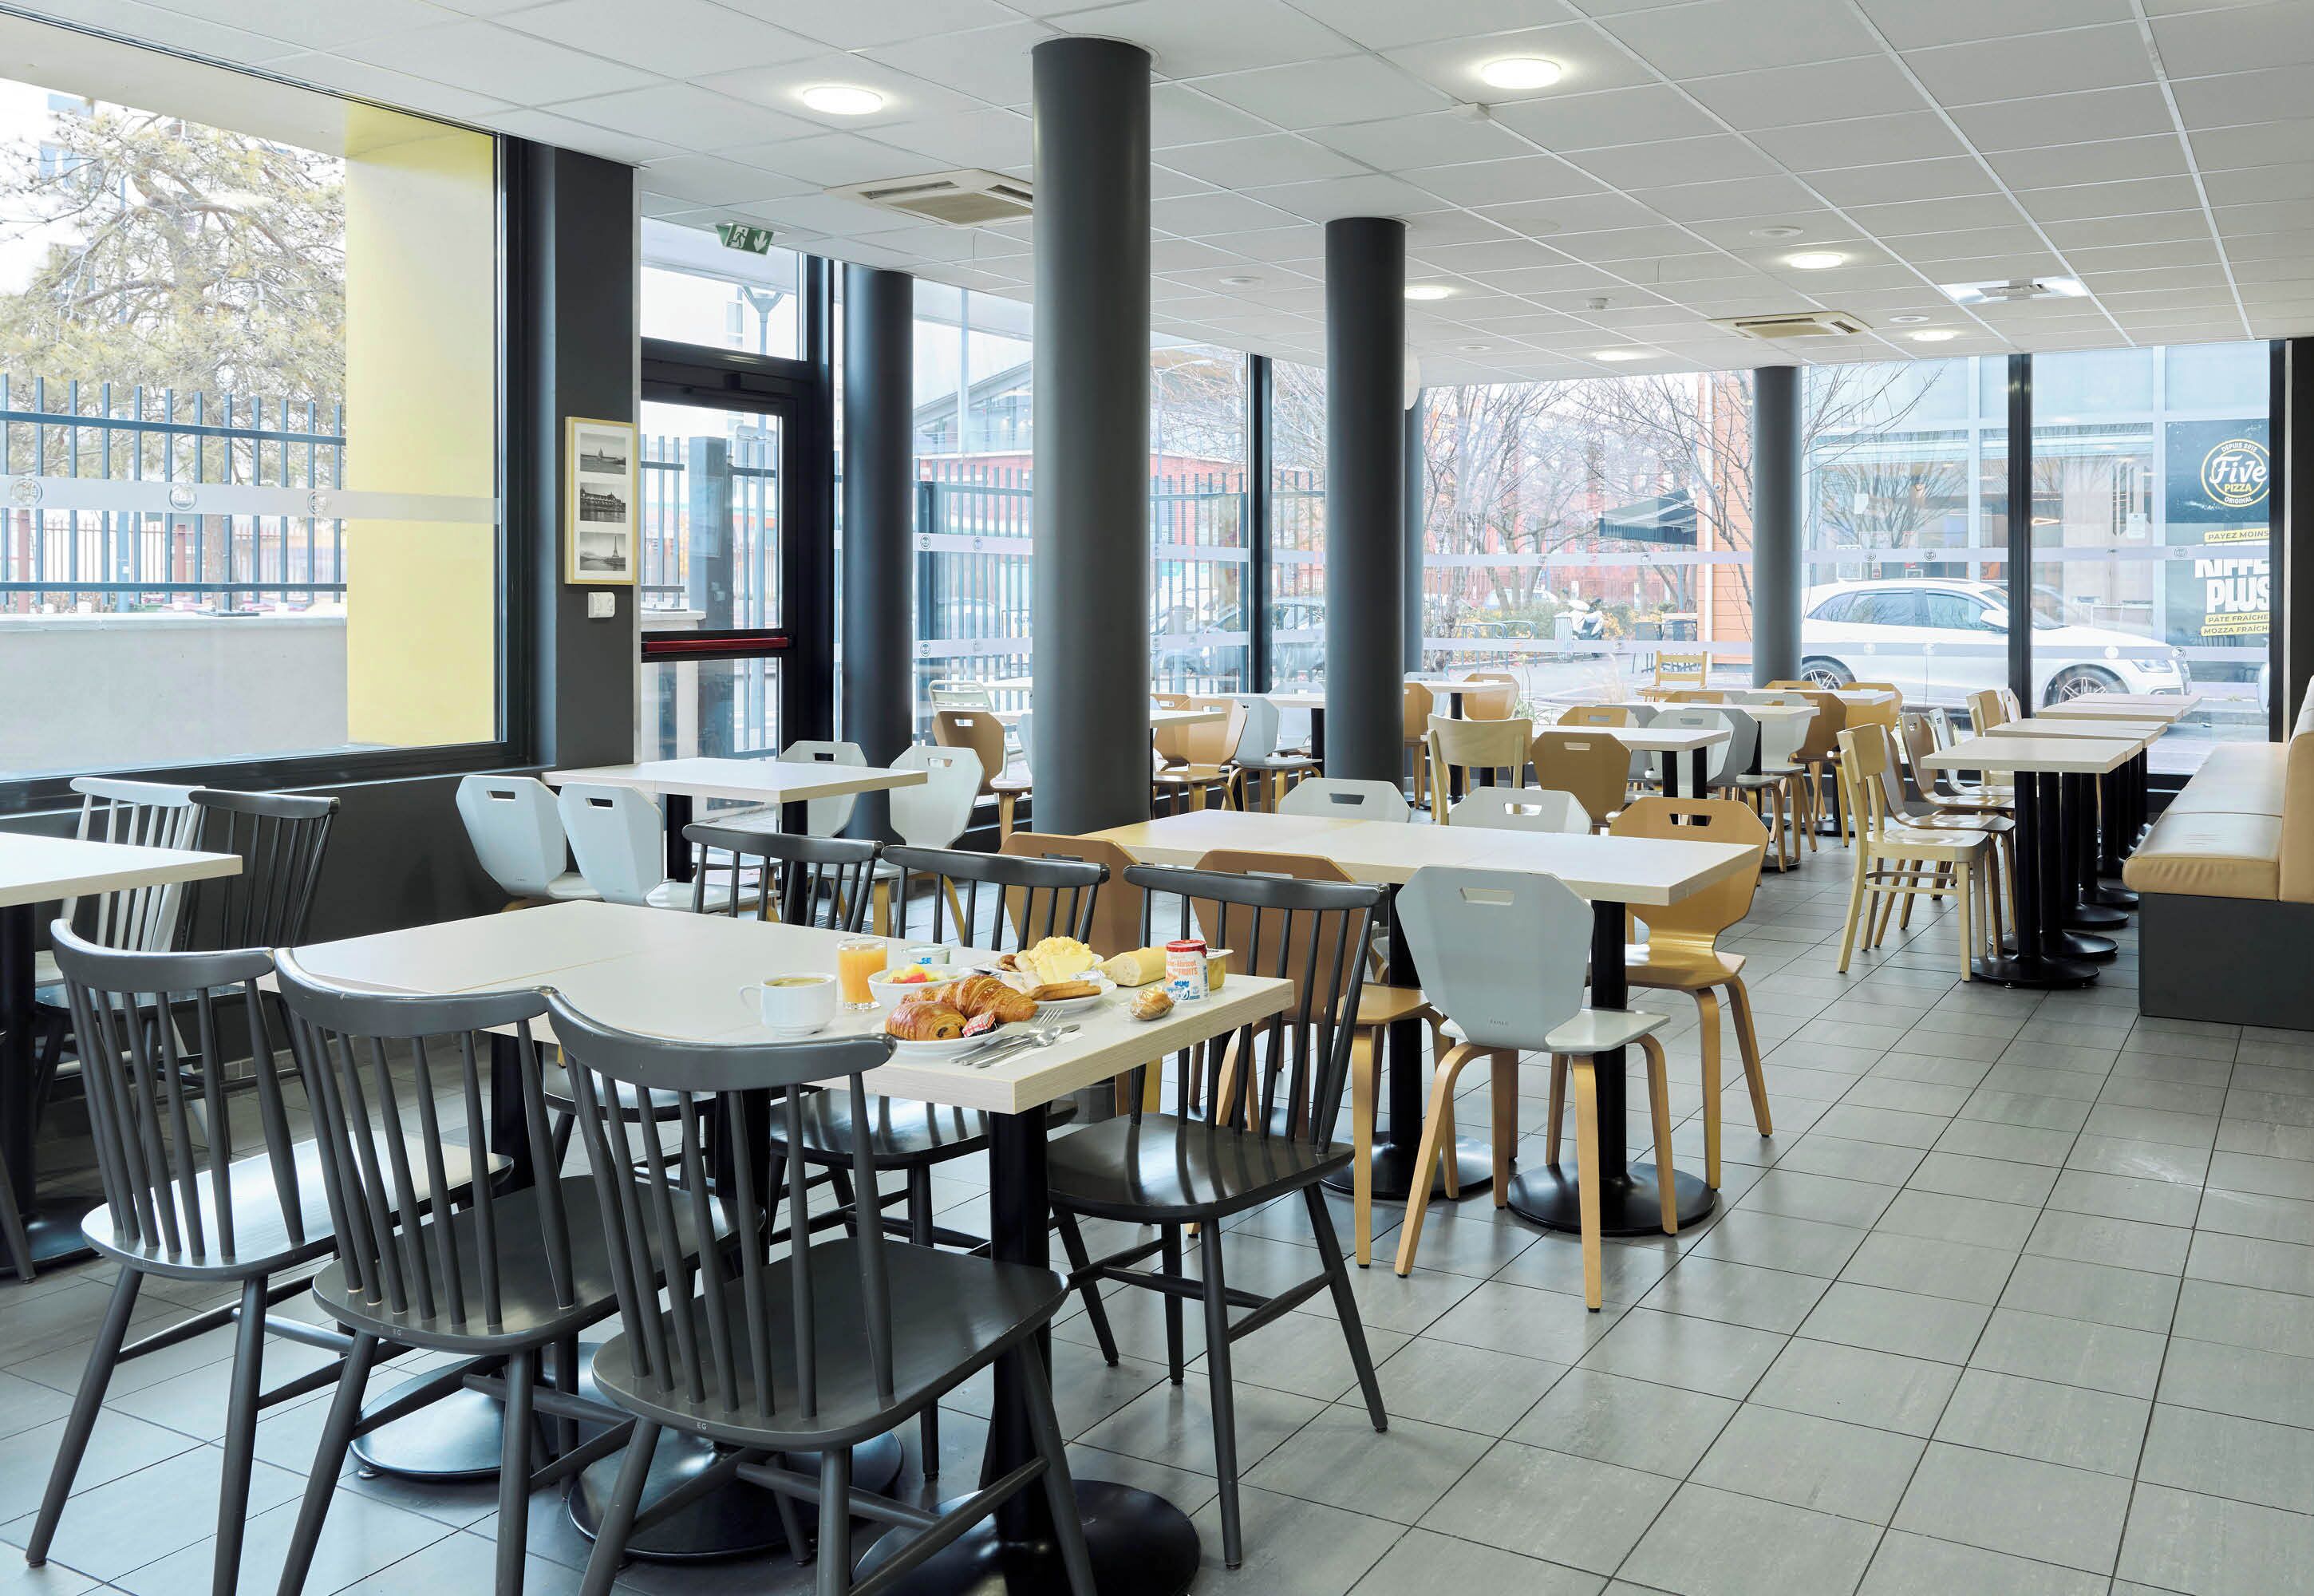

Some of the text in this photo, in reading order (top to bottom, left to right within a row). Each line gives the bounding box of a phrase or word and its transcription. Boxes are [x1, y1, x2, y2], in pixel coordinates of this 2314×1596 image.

[2209, 454, 2268, 484] Five
[2224, 484, 2252, 492] PIZZA
[2239, 530, 2269, 539] MOINS
[2206, 576, 2269, 613] PLUS
